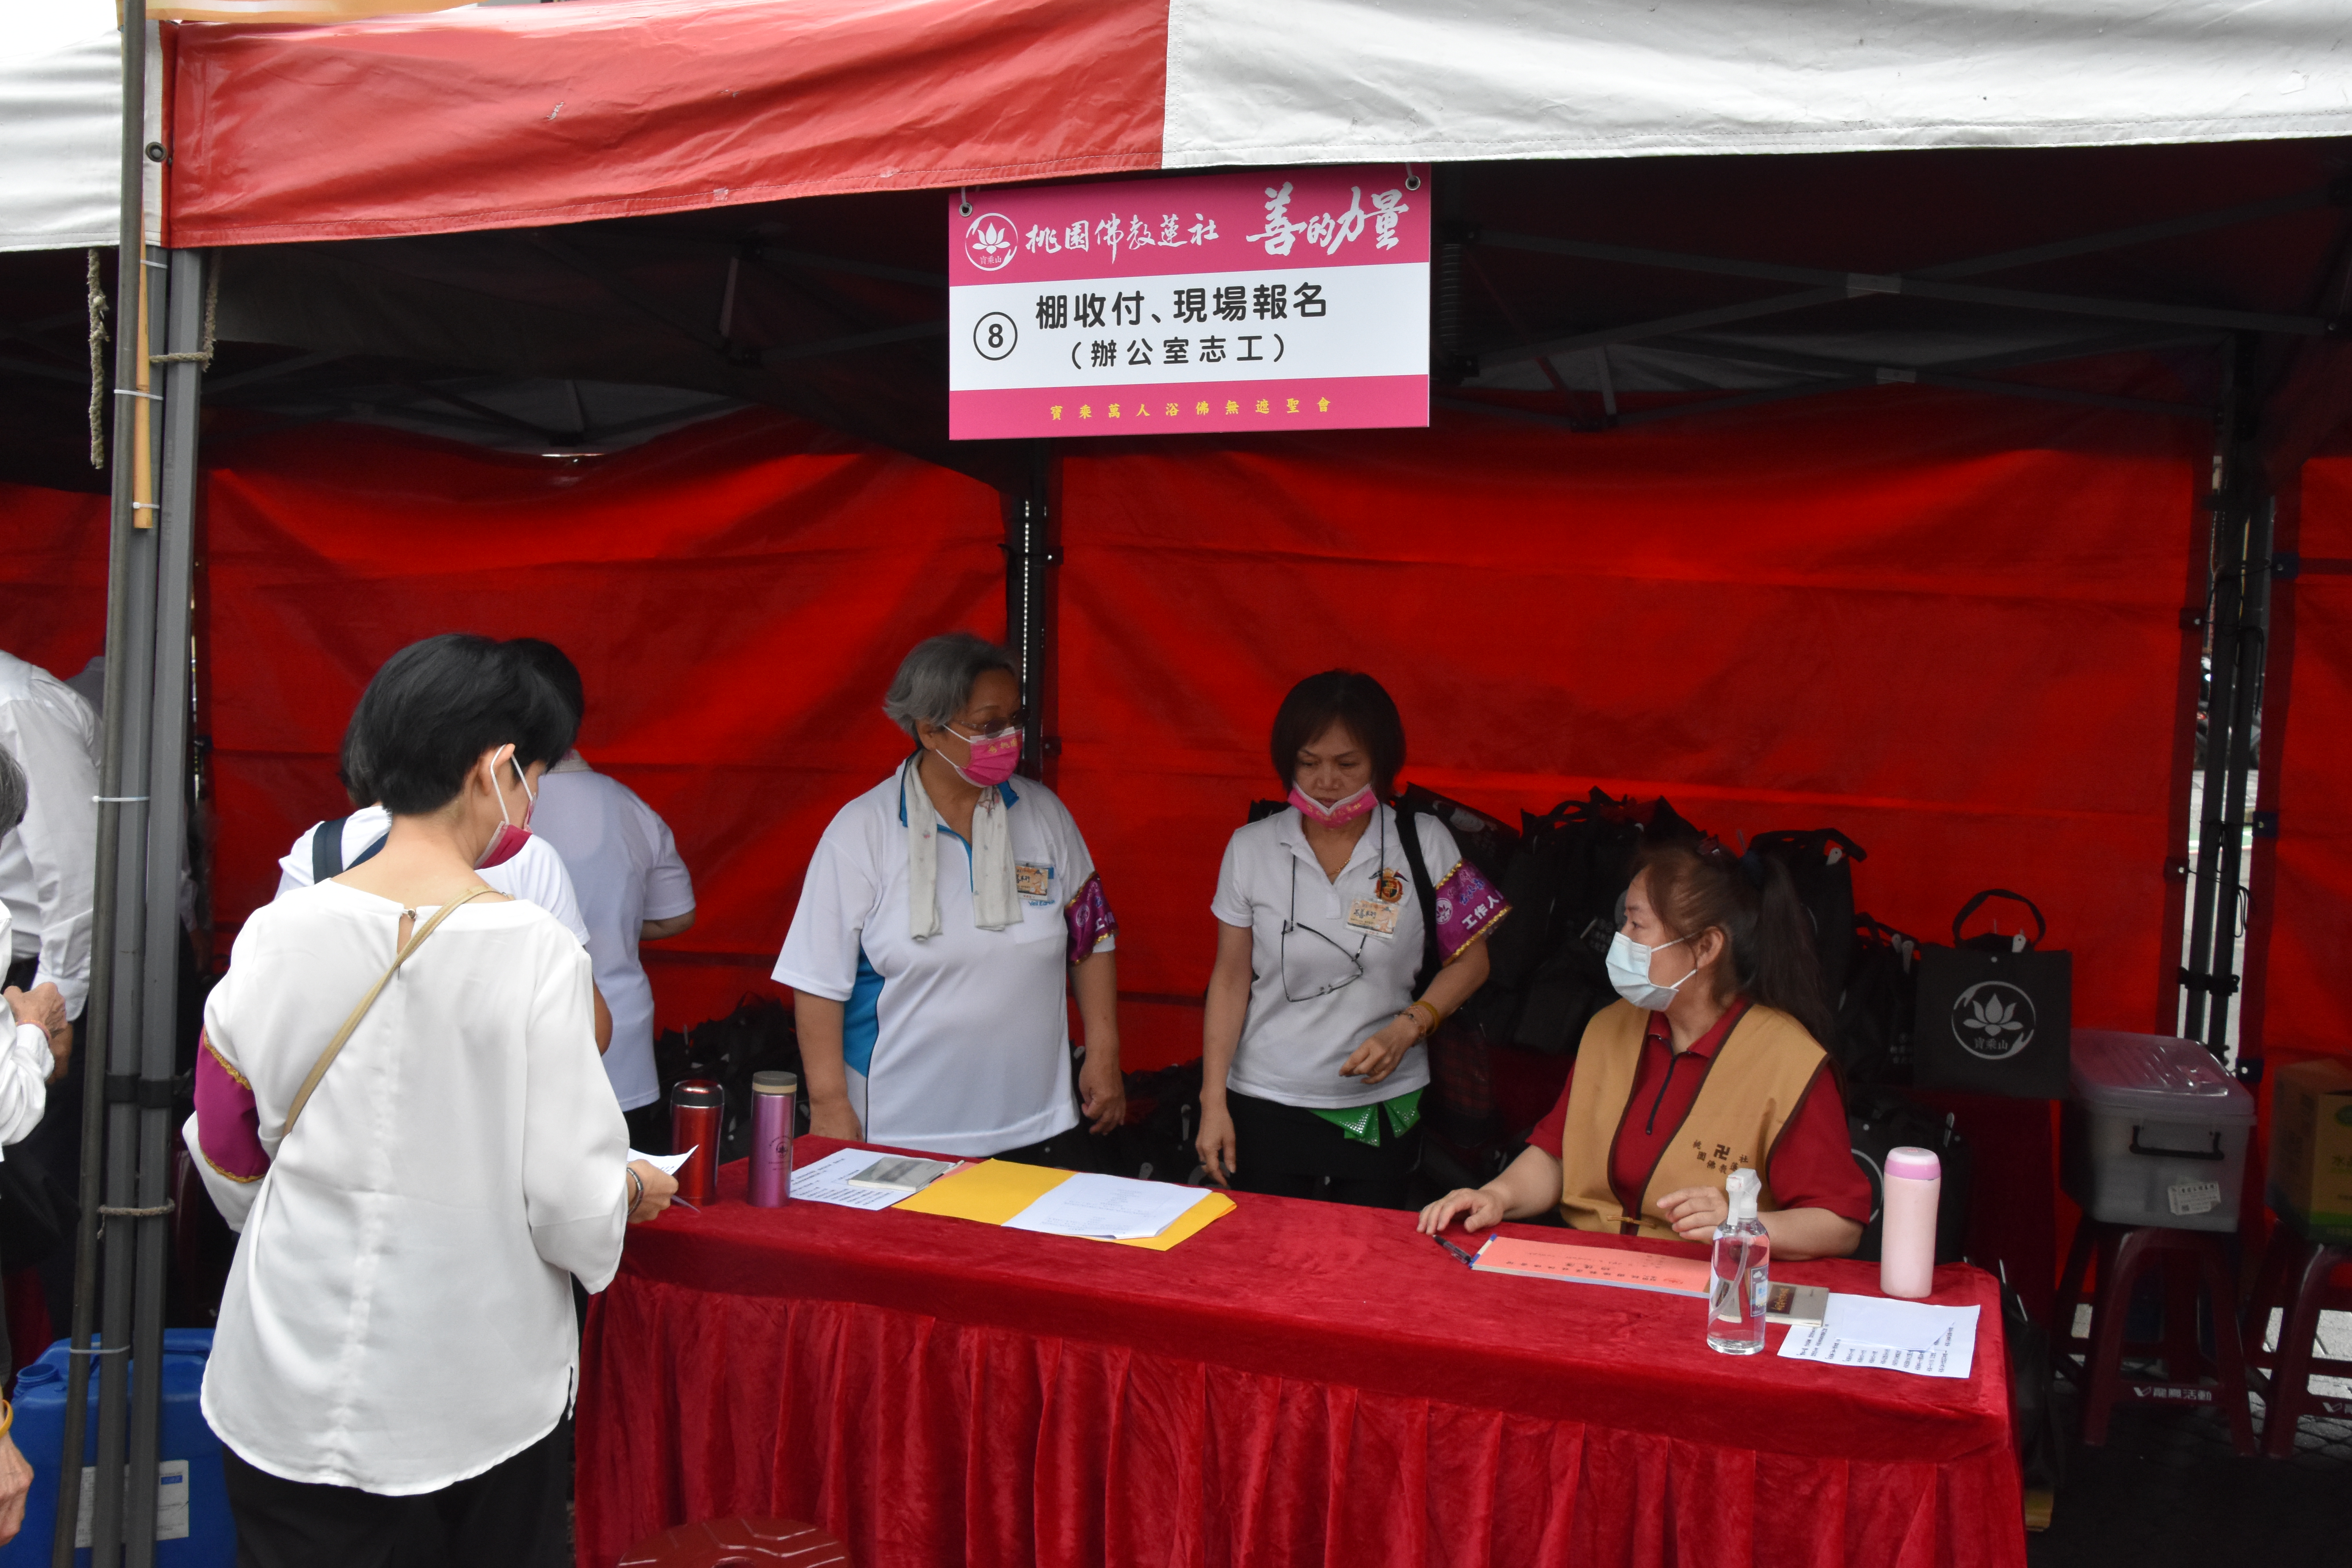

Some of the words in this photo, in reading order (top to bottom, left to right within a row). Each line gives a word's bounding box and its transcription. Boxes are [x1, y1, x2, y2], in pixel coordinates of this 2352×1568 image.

[1025, 212, 1219, 264] 桃園佛教蓮社
[1246, 181, 1409, 256] 善的力量
[1035, 281, 1327, 330] 棚收付、現場報名
[988, 323, 1004, 348] 8
[1071, 333, 1284, 370] （辦公室志工）
[1050, 396, 1330, 420] 寶乘萬人浴佛無遮聖會
[1461, 889, 1504, 931] 工作人
